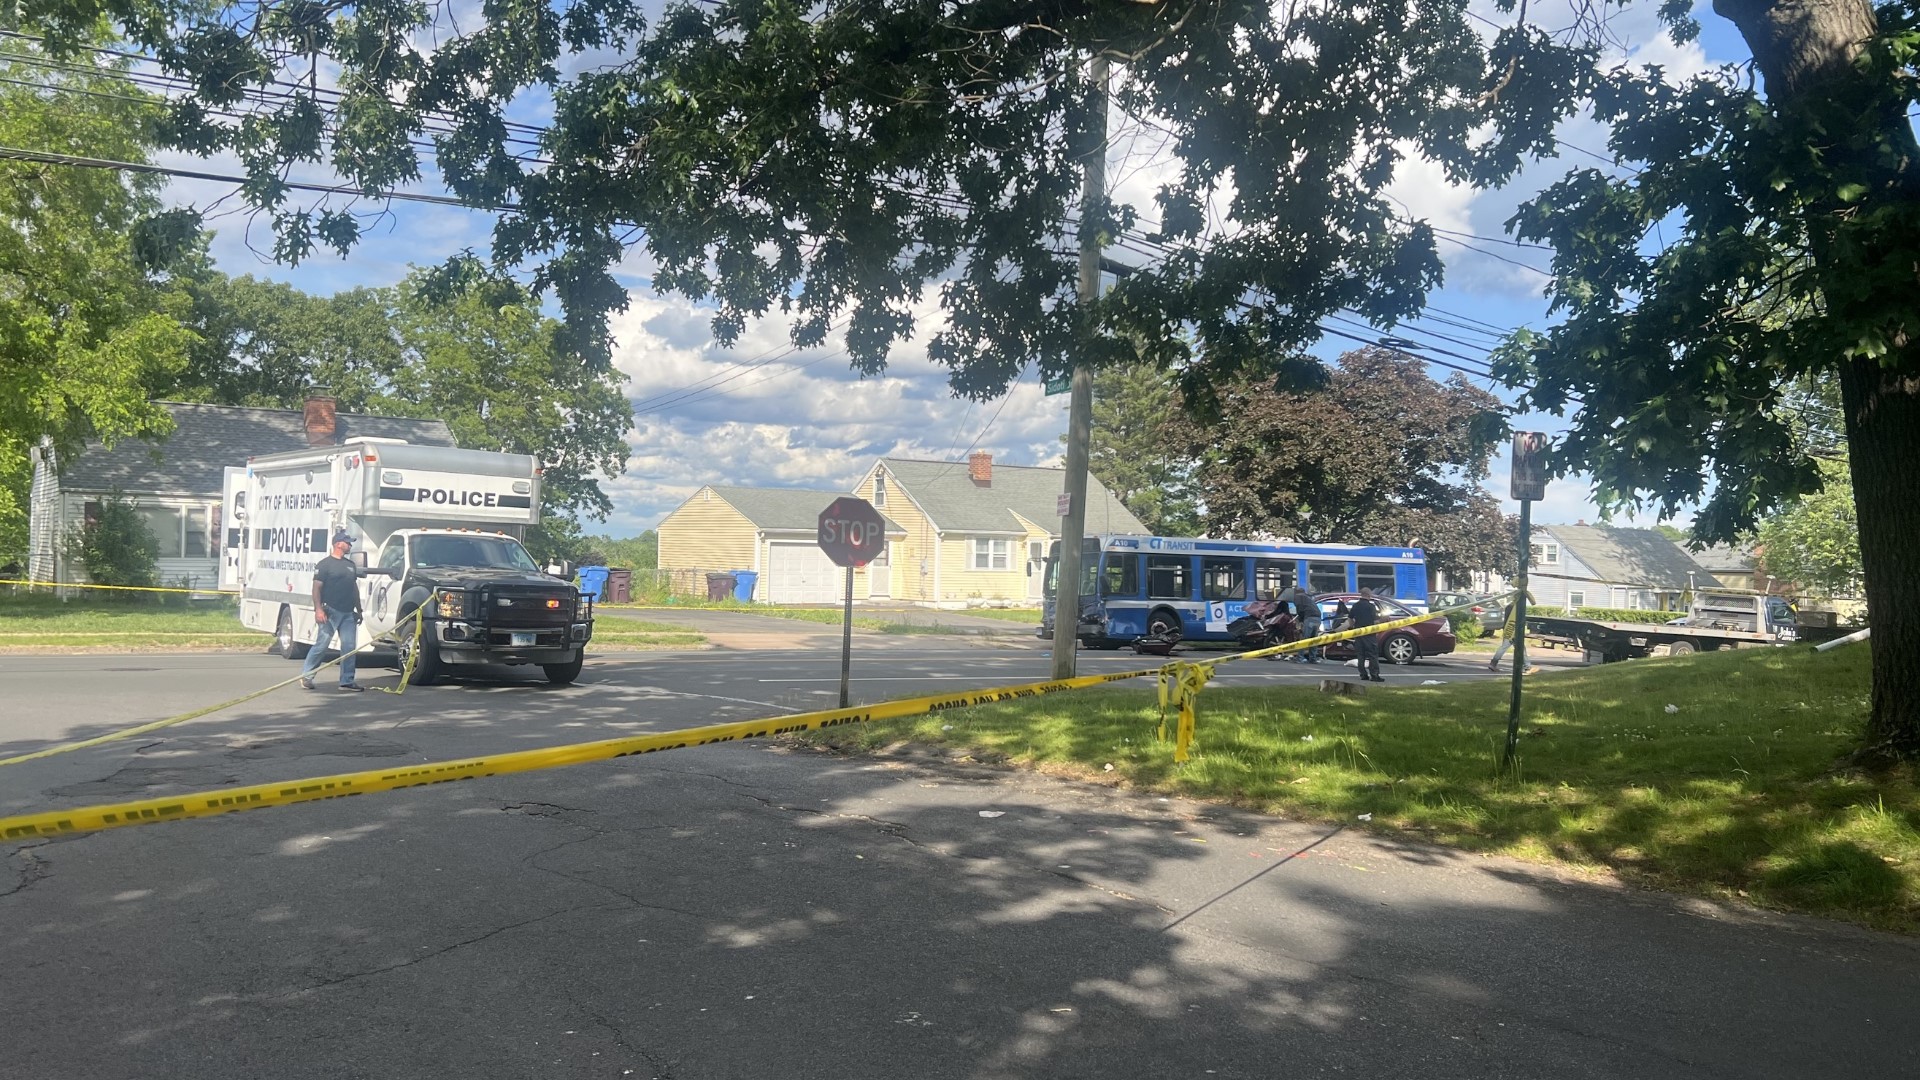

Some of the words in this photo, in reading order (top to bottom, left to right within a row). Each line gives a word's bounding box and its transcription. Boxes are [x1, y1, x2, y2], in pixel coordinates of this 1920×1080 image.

[258, 496, 272, 510] CITY
[274, 495, 282, 510] OF
[284, 494, 299, 510] NEW
[300, 492, 329, 509] BRITAIN
[417, 488, 496, 507] POLICE
[271, 527, 310, 553] POLICE
[823, 518, 880, 546] STOP
[1150, 538, 1162, 550] CT
[1163, 541, 1195, 551] TRANSIT
